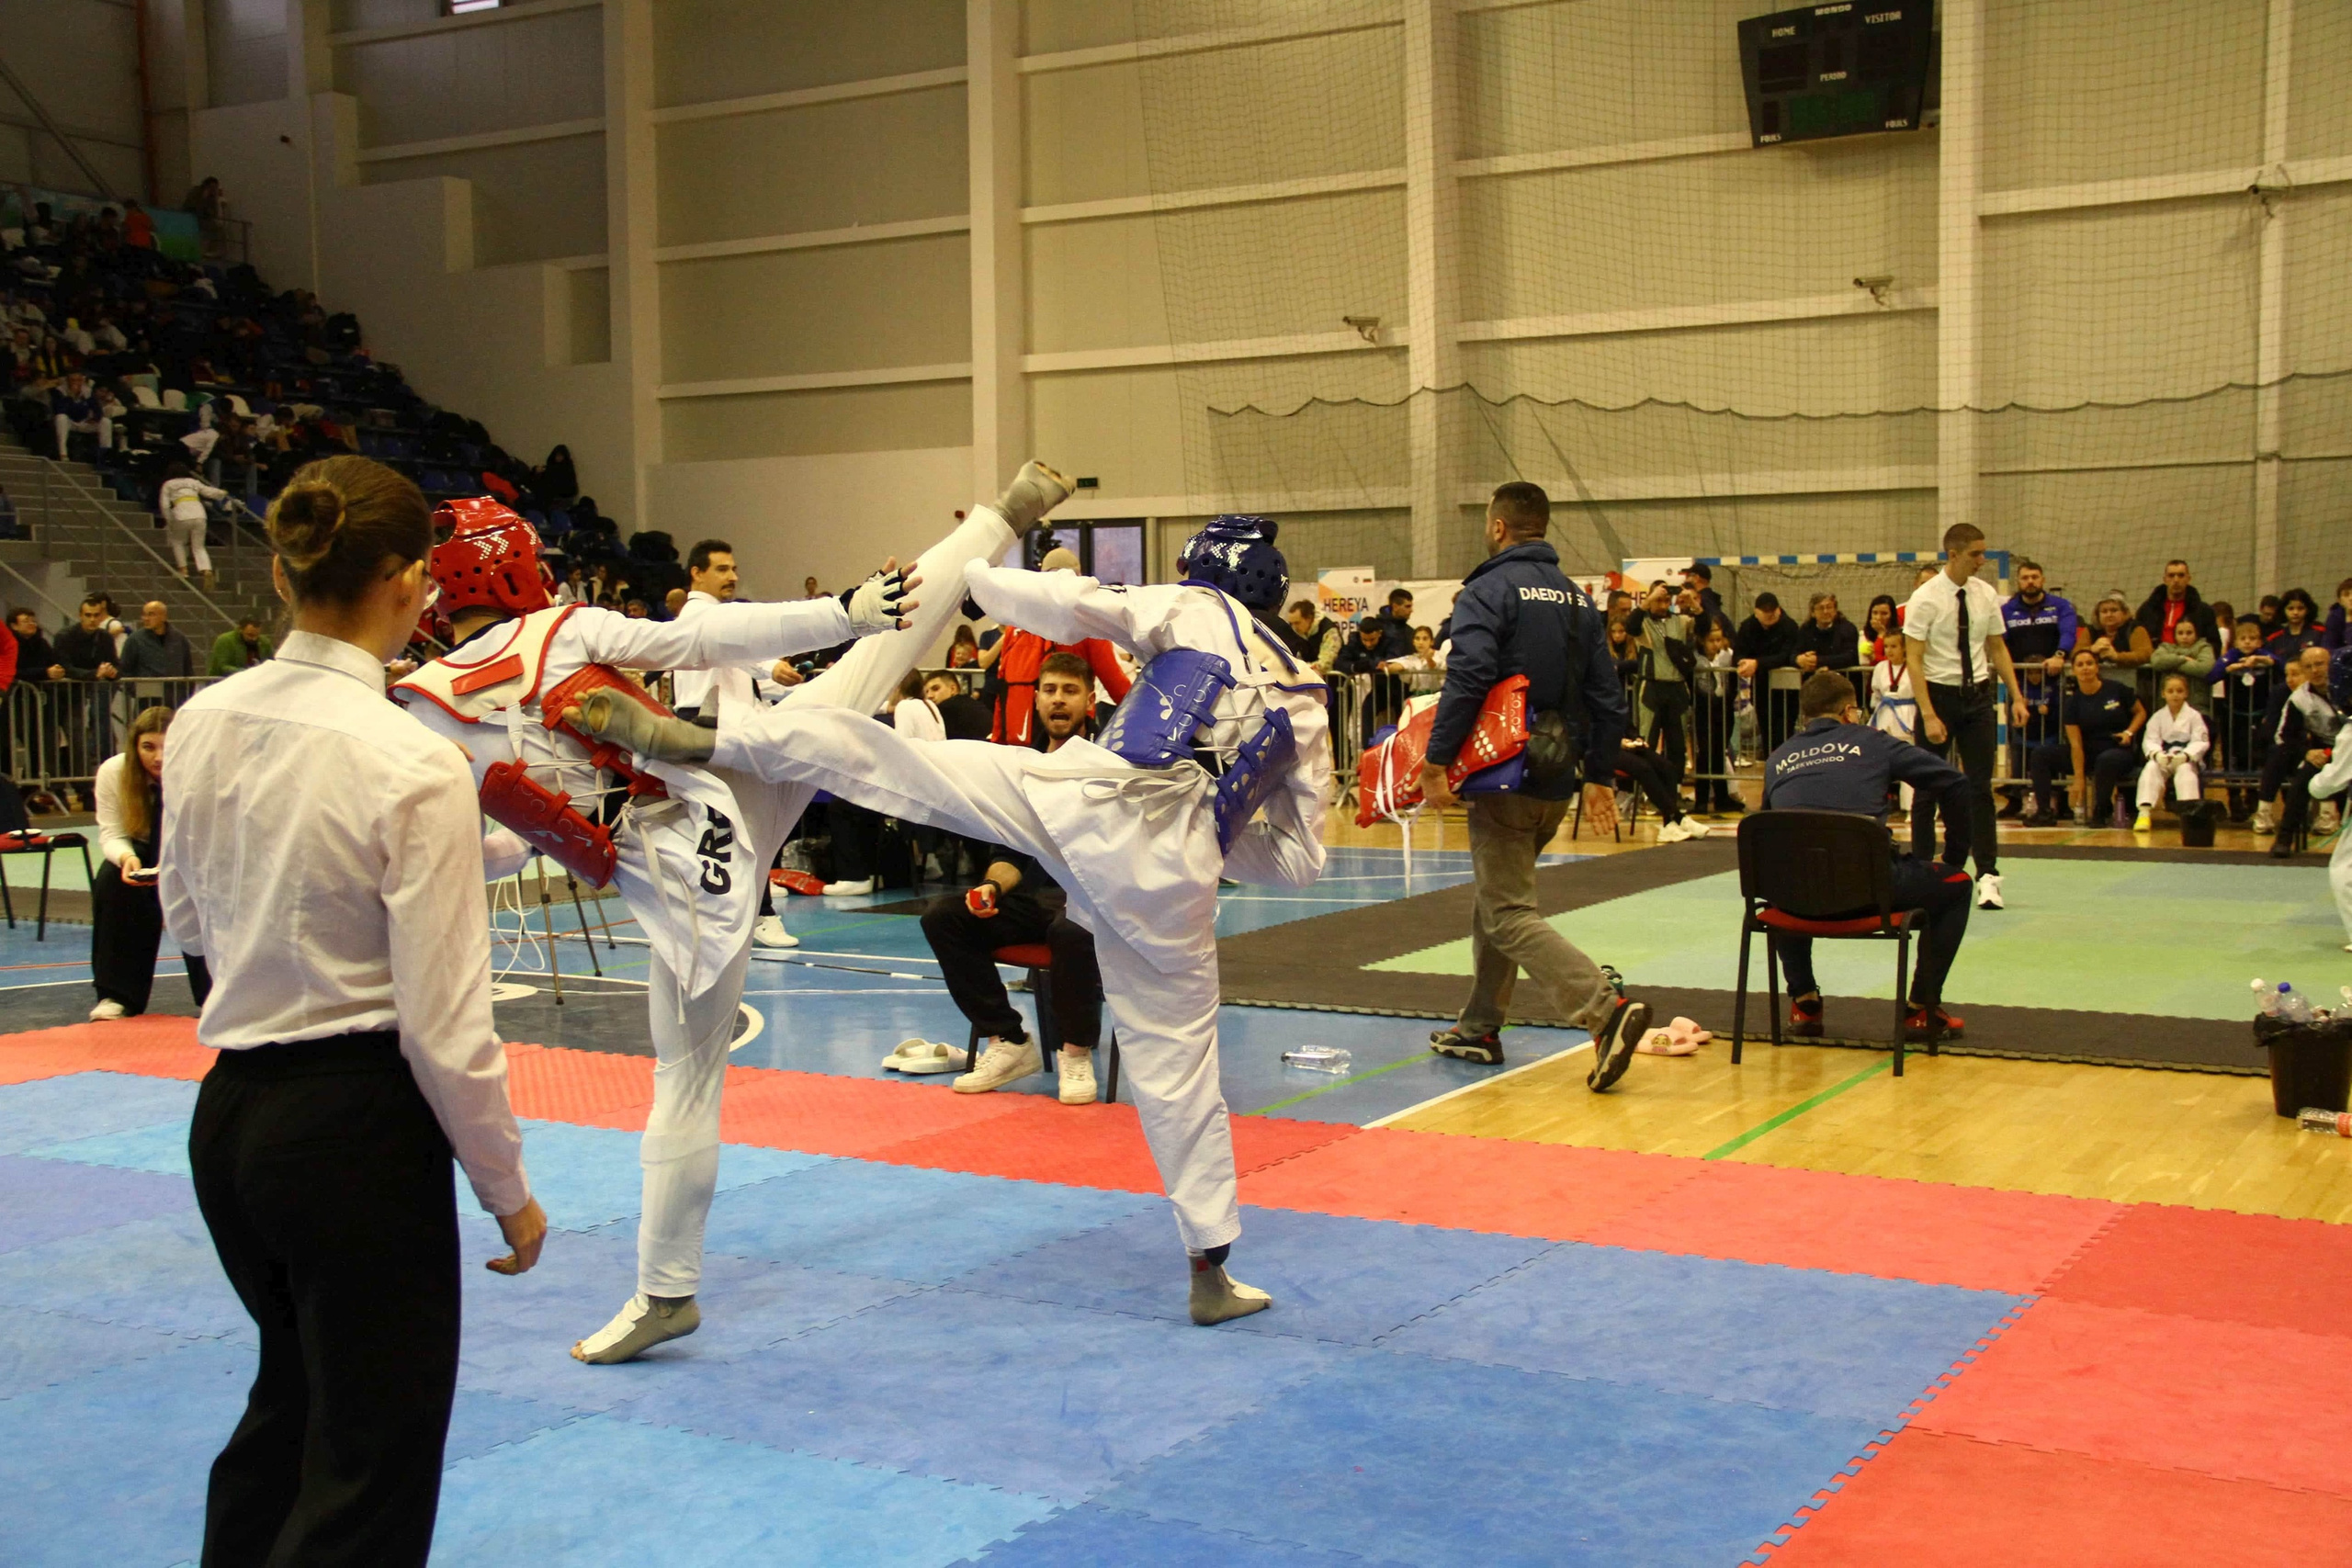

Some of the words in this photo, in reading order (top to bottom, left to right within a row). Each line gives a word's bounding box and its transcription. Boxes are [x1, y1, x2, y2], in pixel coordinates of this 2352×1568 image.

[1864, 10, 1903, 24] VISITOR
[1771, 26, 1796, 38] HOME
[1820, 71, 1847, 82] PERIOD
[1885, 118, 1908, 129] FOULS
[1760, 133, 1782, 143] FOULS
[1519, 587, 1566, 604] DAEDO
[1323, 597, 1369, 613] HEREYA
[1775, 742, 1861, 775] MOLDOVA
[1786, 755, 1845, 773] TAEKWONDO
